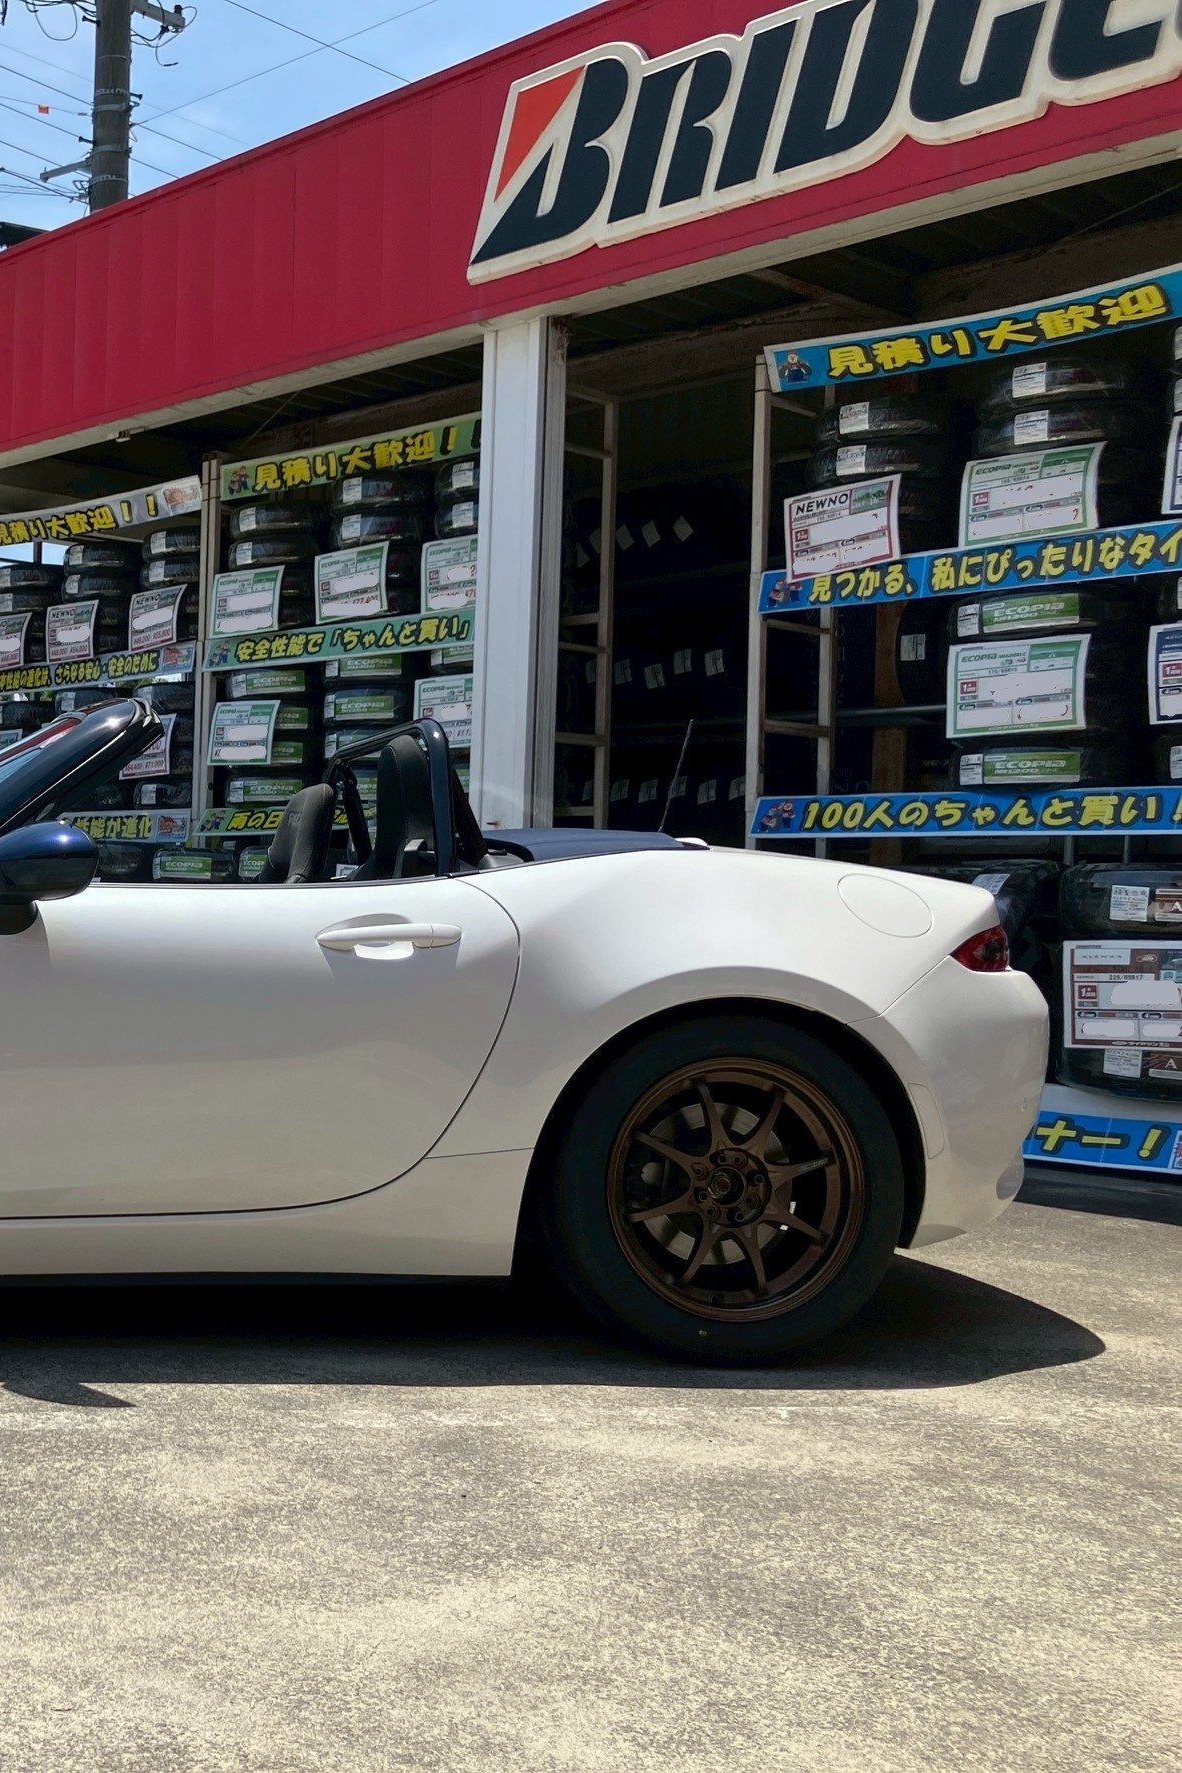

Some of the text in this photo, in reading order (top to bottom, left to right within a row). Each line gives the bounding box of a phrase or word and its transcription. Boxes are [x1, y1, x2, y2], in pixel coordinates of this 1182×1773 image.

[828, 285, 1167, 377] 見積り大歓迎
[253, 425, 480, 491] 見積り大歓迎！
[795, 493, 849, 516] NEWNO
[236, 616, 470, 662] 安全性能で「ちゃんと買い」
